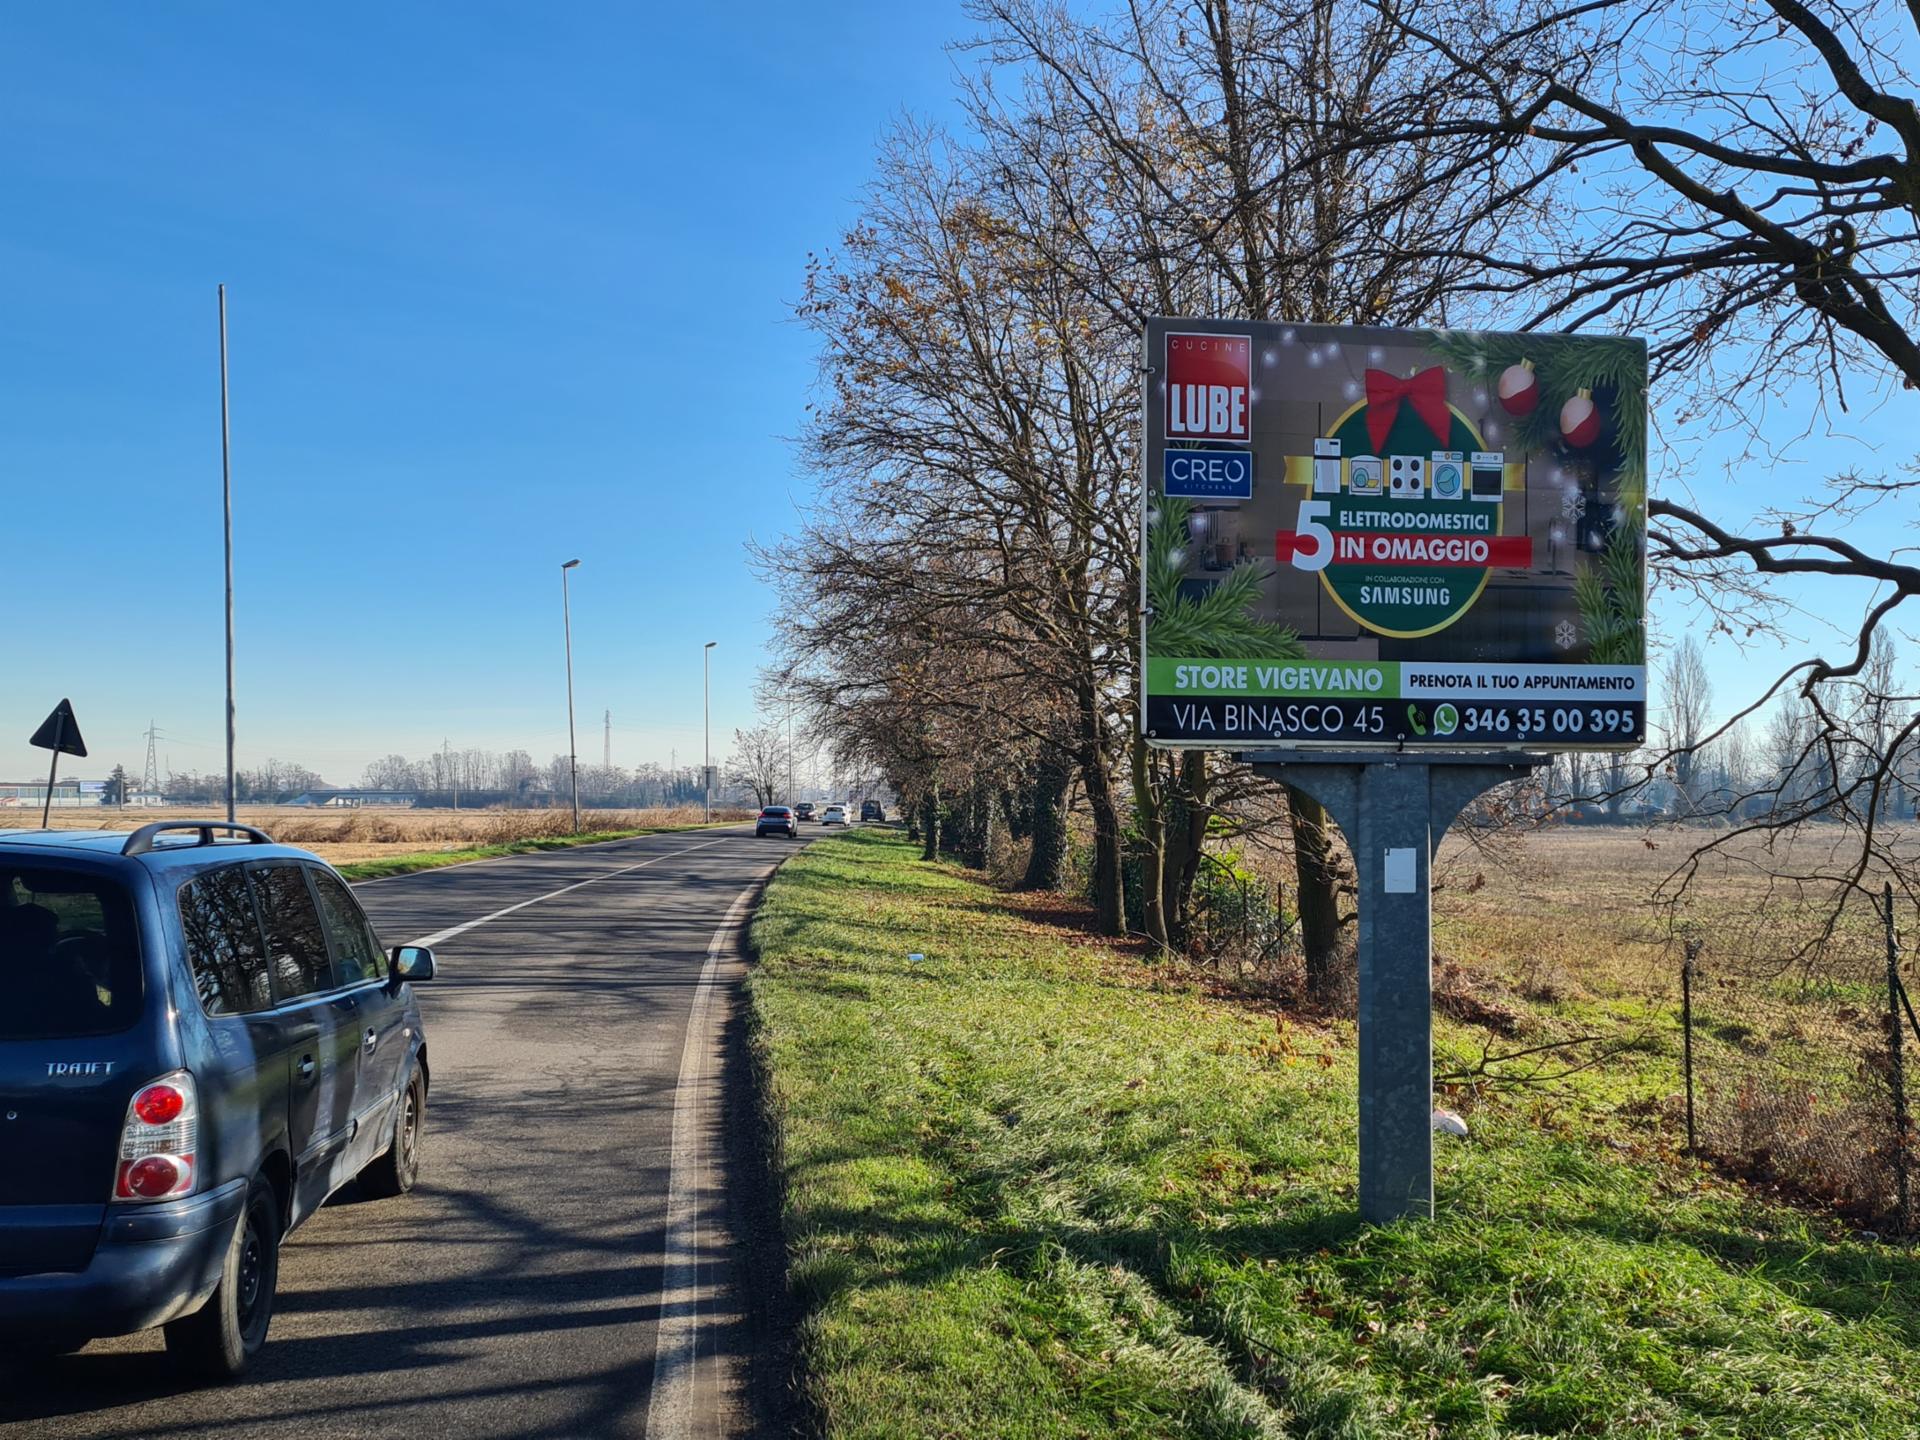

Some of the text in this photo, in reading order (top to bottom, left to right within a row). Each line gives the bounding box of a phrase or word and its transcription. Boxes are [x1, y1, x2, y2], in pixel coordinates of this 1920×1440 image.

[1171, 339, 1245, 353] CUCINE
[1171, 383, 1245, 434] LUBE
[1171, 458, 1245, 483] CREO
[1339, 510, 1489, 530] ELETTRODOMESTICI
[1291, 500, 1335, 571] 5
[1340, 537, 1489, 562] IN OMAGGIO
[1374, 575, 1428, 584] COLLABORAZIONE
[1429, 576, 1445, 584] CON
[1360, 586, 1450, 605] SAMSUNG
[1175, 665, 1383, 691] STORE VIGEVANO
[1410, 674, 1635, 690] PRENOTA IL TUO APPUNTAMENTO
[1173, 704, 1384, 733] VIA BINASCO 45
[1464, 707, 1635, 733] 346 35 00 395
